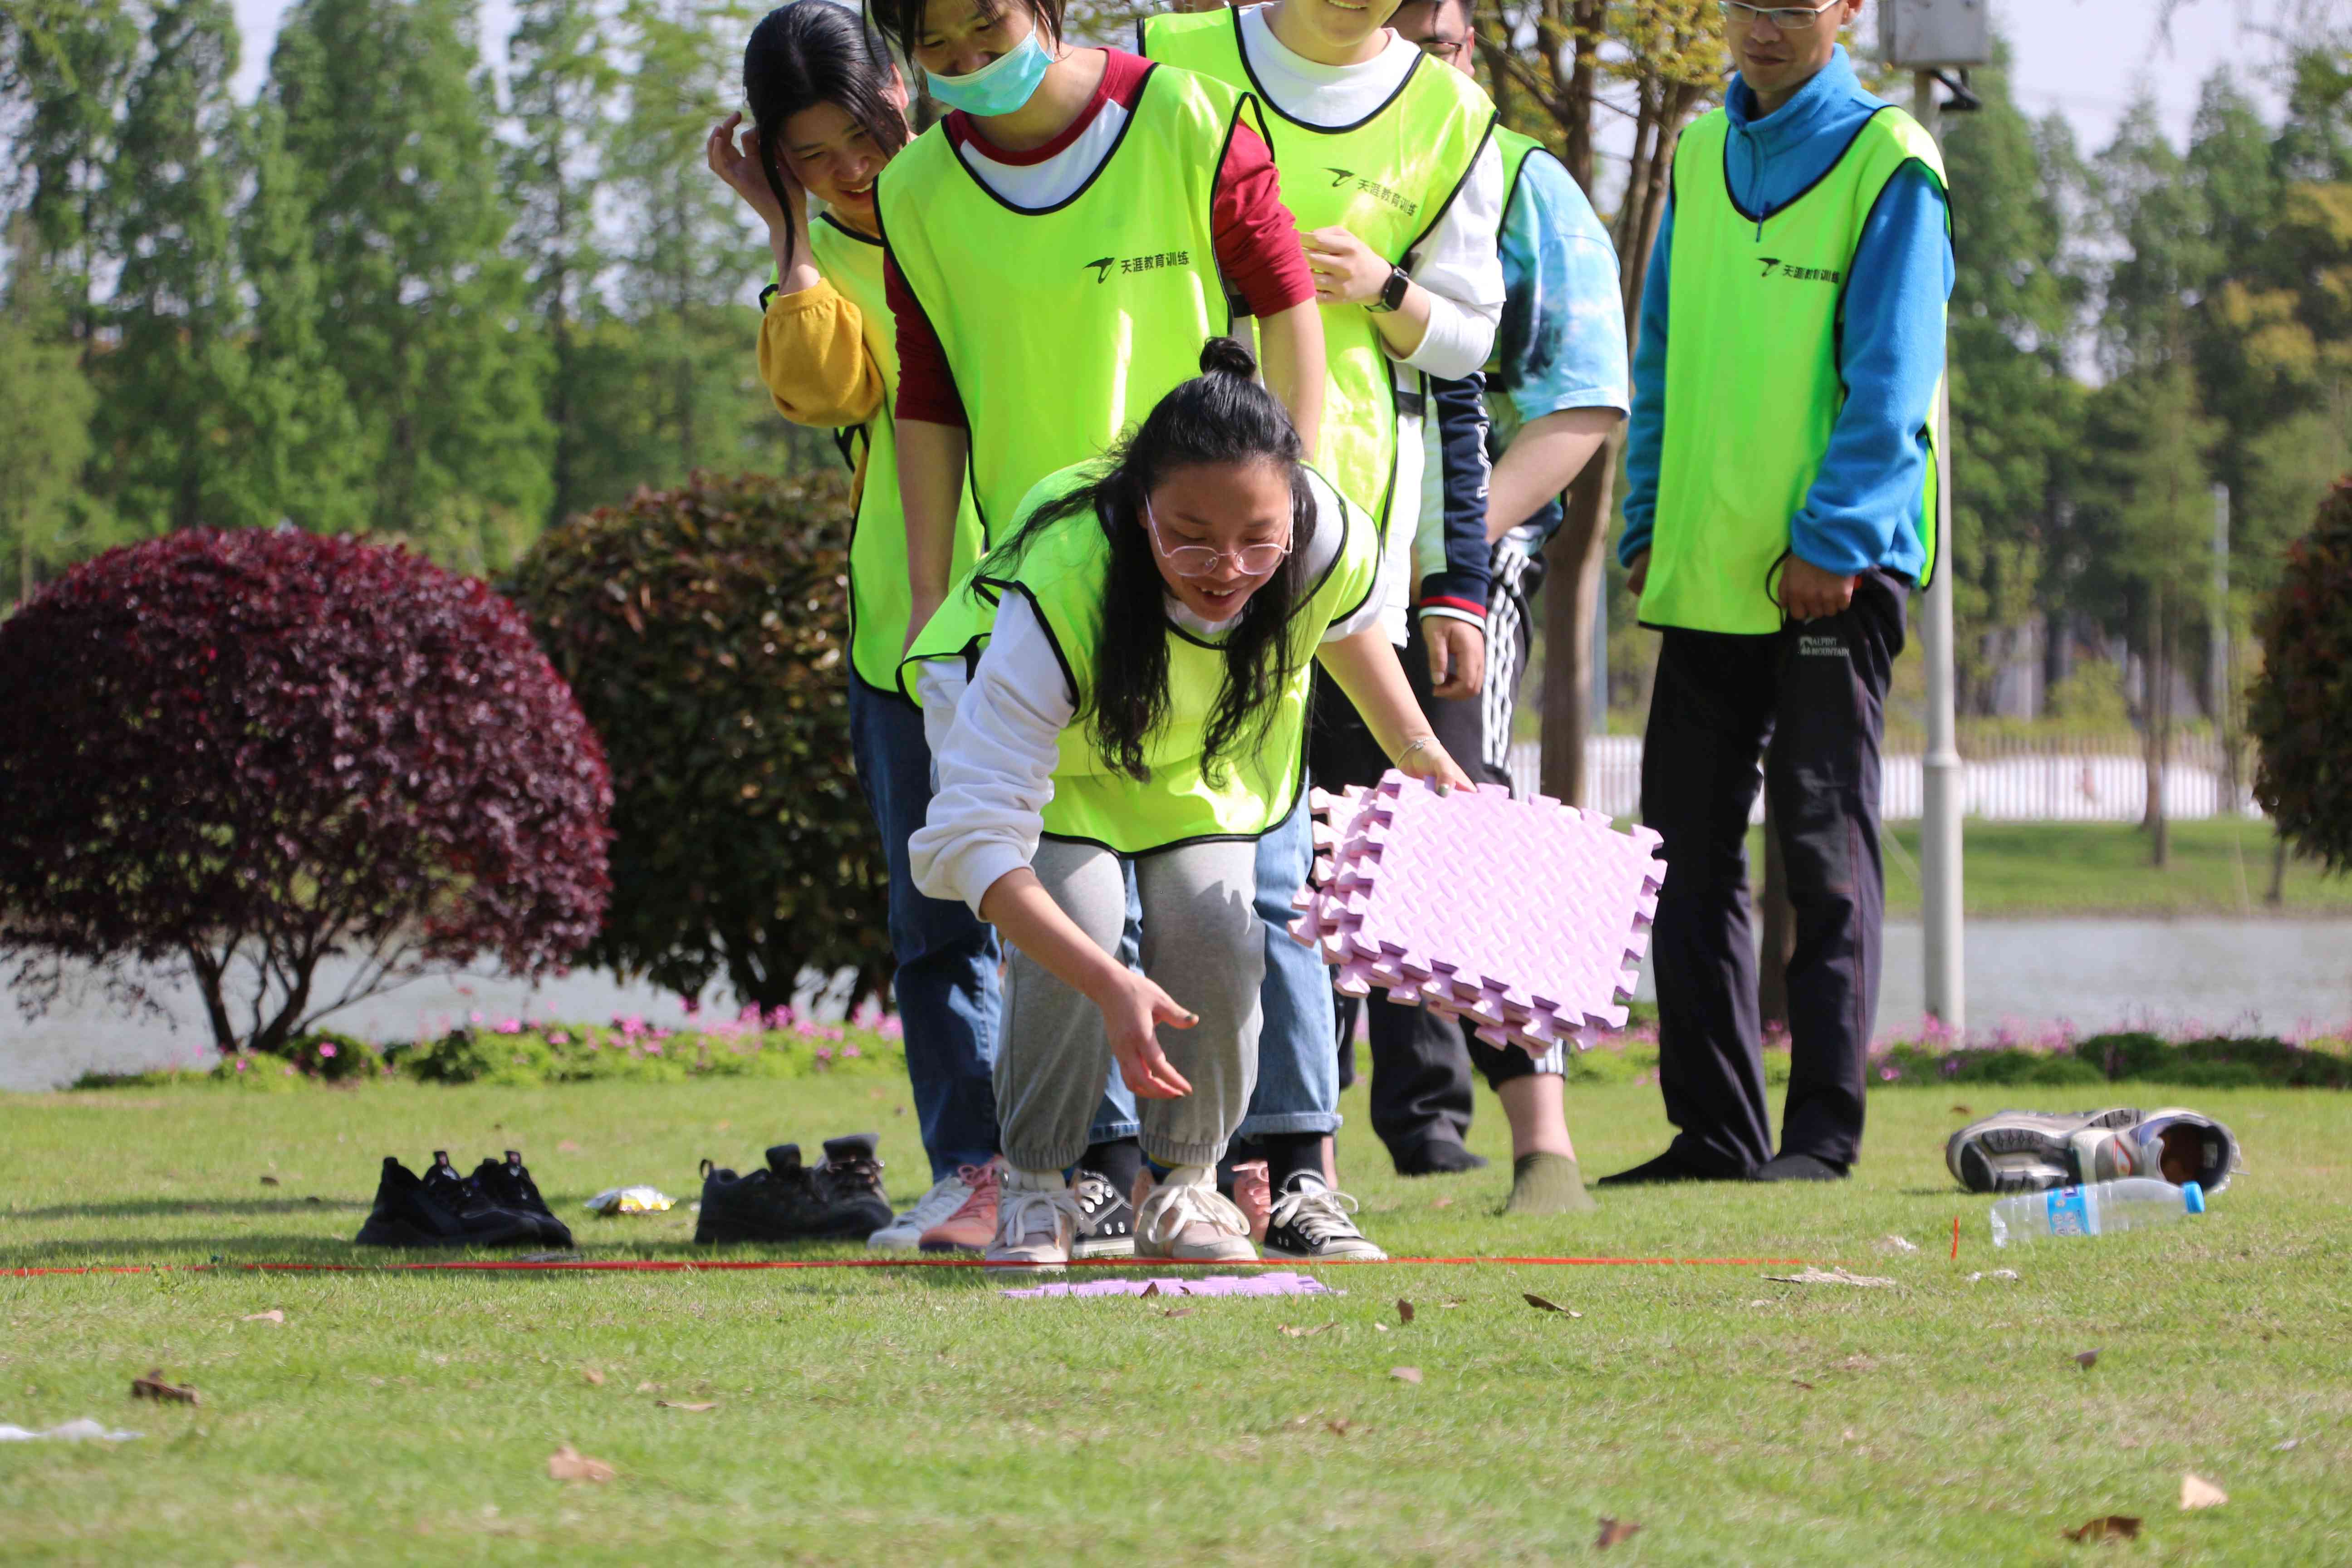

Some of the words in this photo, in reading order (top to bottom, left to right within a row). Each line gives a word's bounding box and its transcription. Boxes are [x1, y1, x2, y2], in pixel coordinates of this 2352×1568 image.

[1357, 179, 1418, 216] 天涯教育训练
[1121, 250, 1190, 274] 天涯教育训练
[1782, 265, 1840, 284] 天涯教育训练
[1812, 647, 1850, 657] MOUNTAIN
